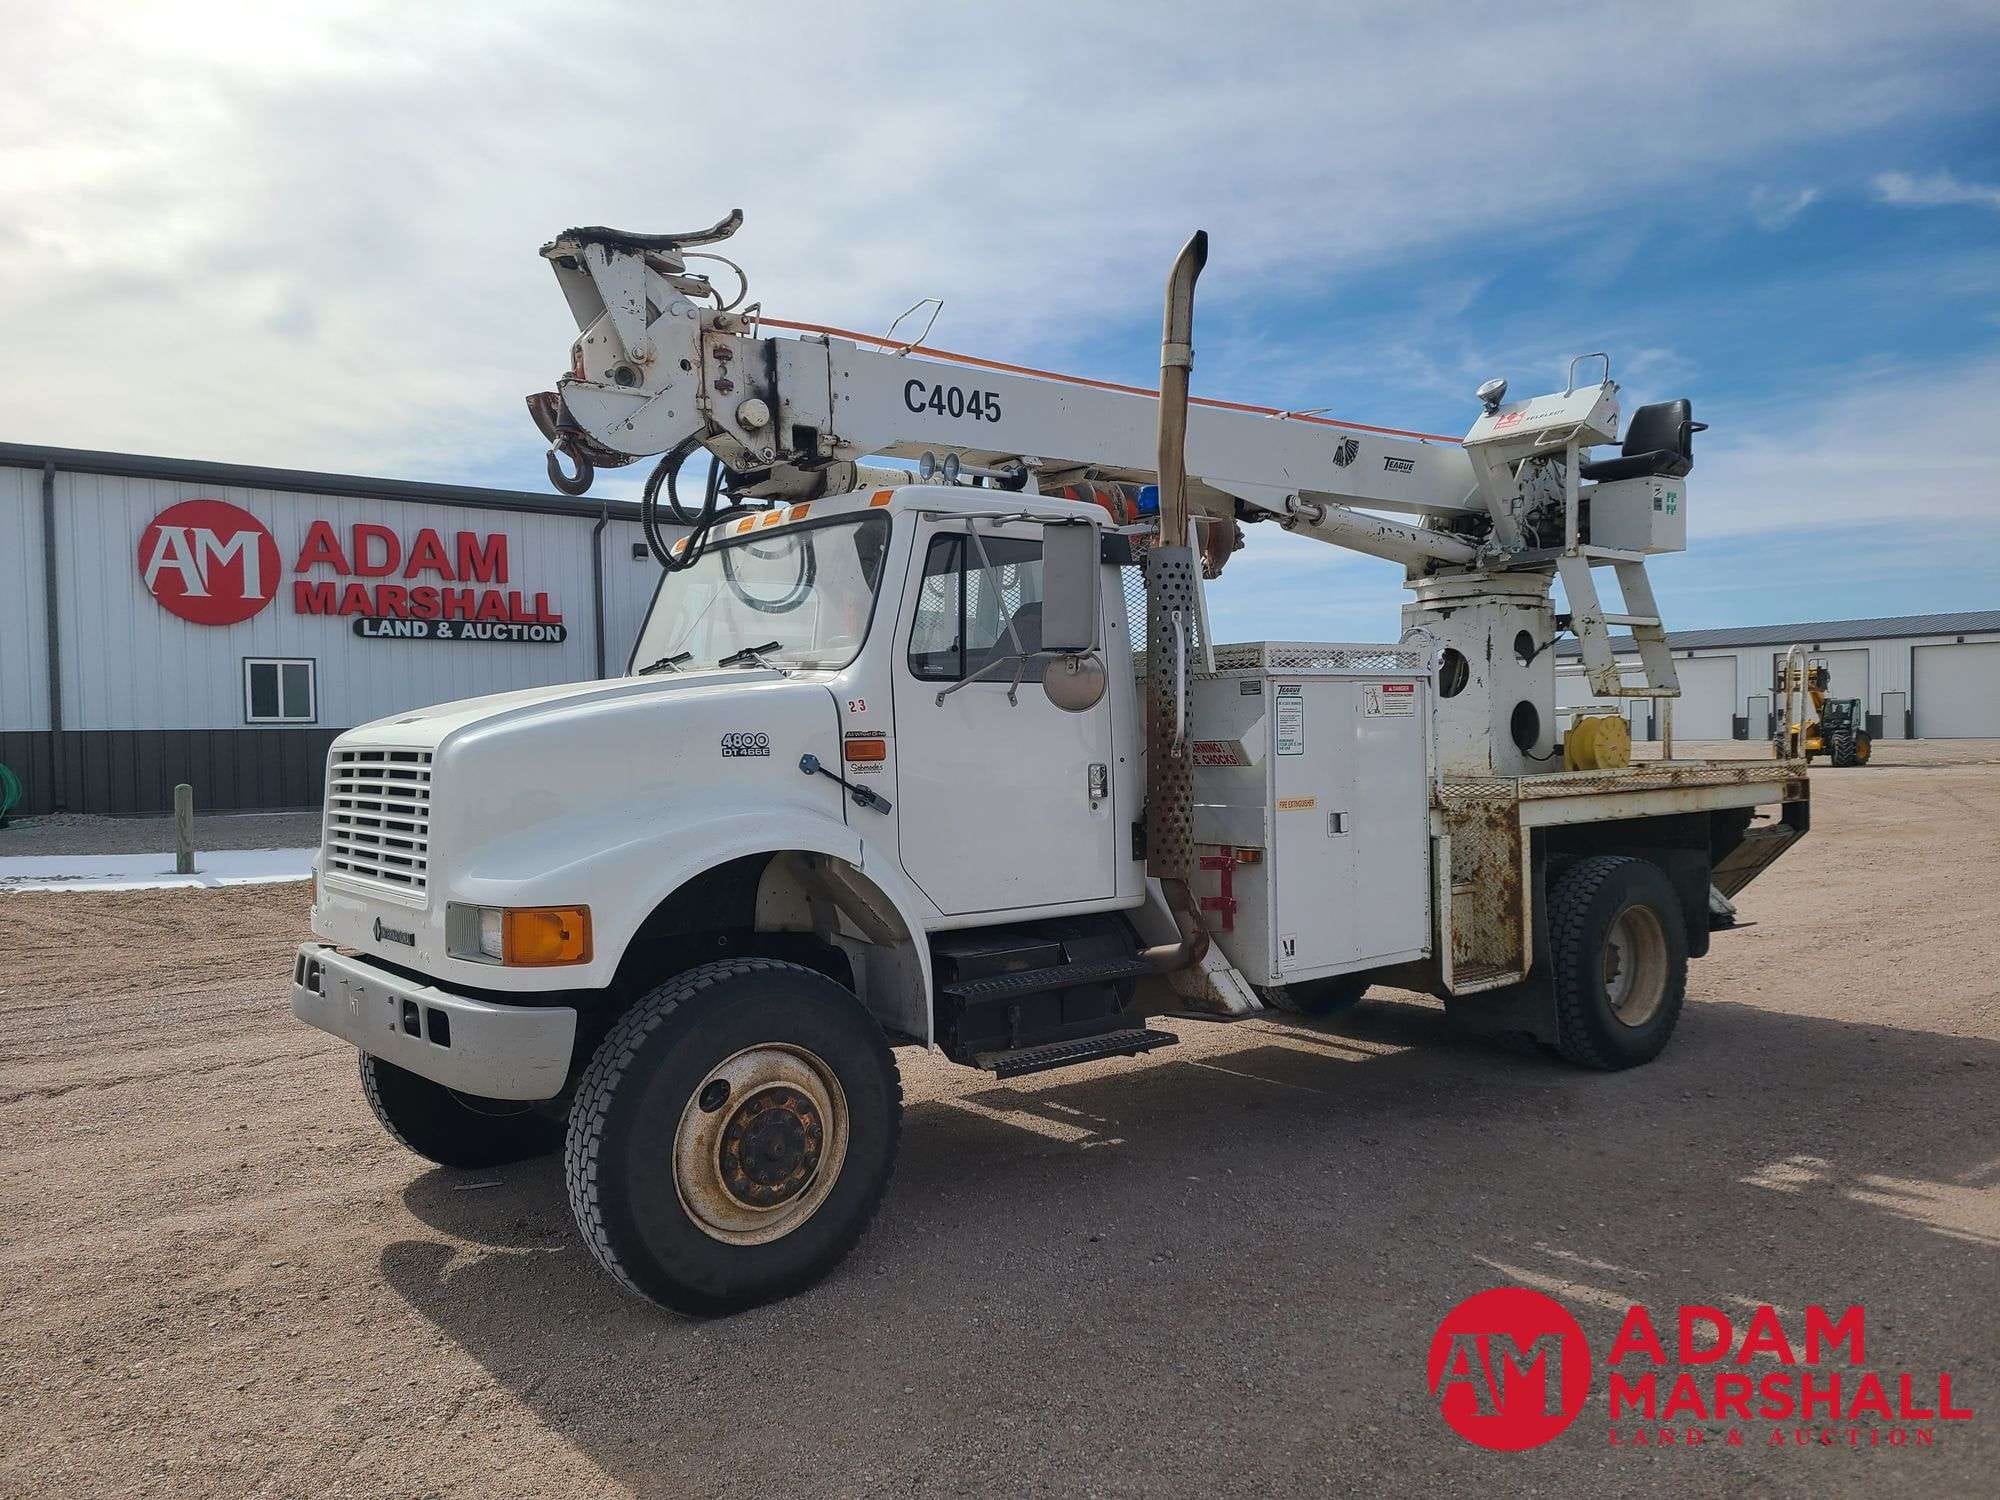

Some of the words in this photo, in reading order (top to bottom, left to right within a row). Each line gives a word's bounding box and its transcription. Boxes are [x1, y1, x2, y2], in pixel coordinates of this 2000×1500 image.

[904, 379, 1002, 423] C4045
[1383, 456, 1415, 471] TEAGUE
[143, 525, 264, 600] AM
[295, 520, 508, 584] ADAM
[294, 580, 563, 624] MARSHALL
[363, 619, 428, 637] LAND
[436, 622, 453, 638] &
[460, 623, 560, 641] AUCTION
[721, 732, 769, 748] 4800
